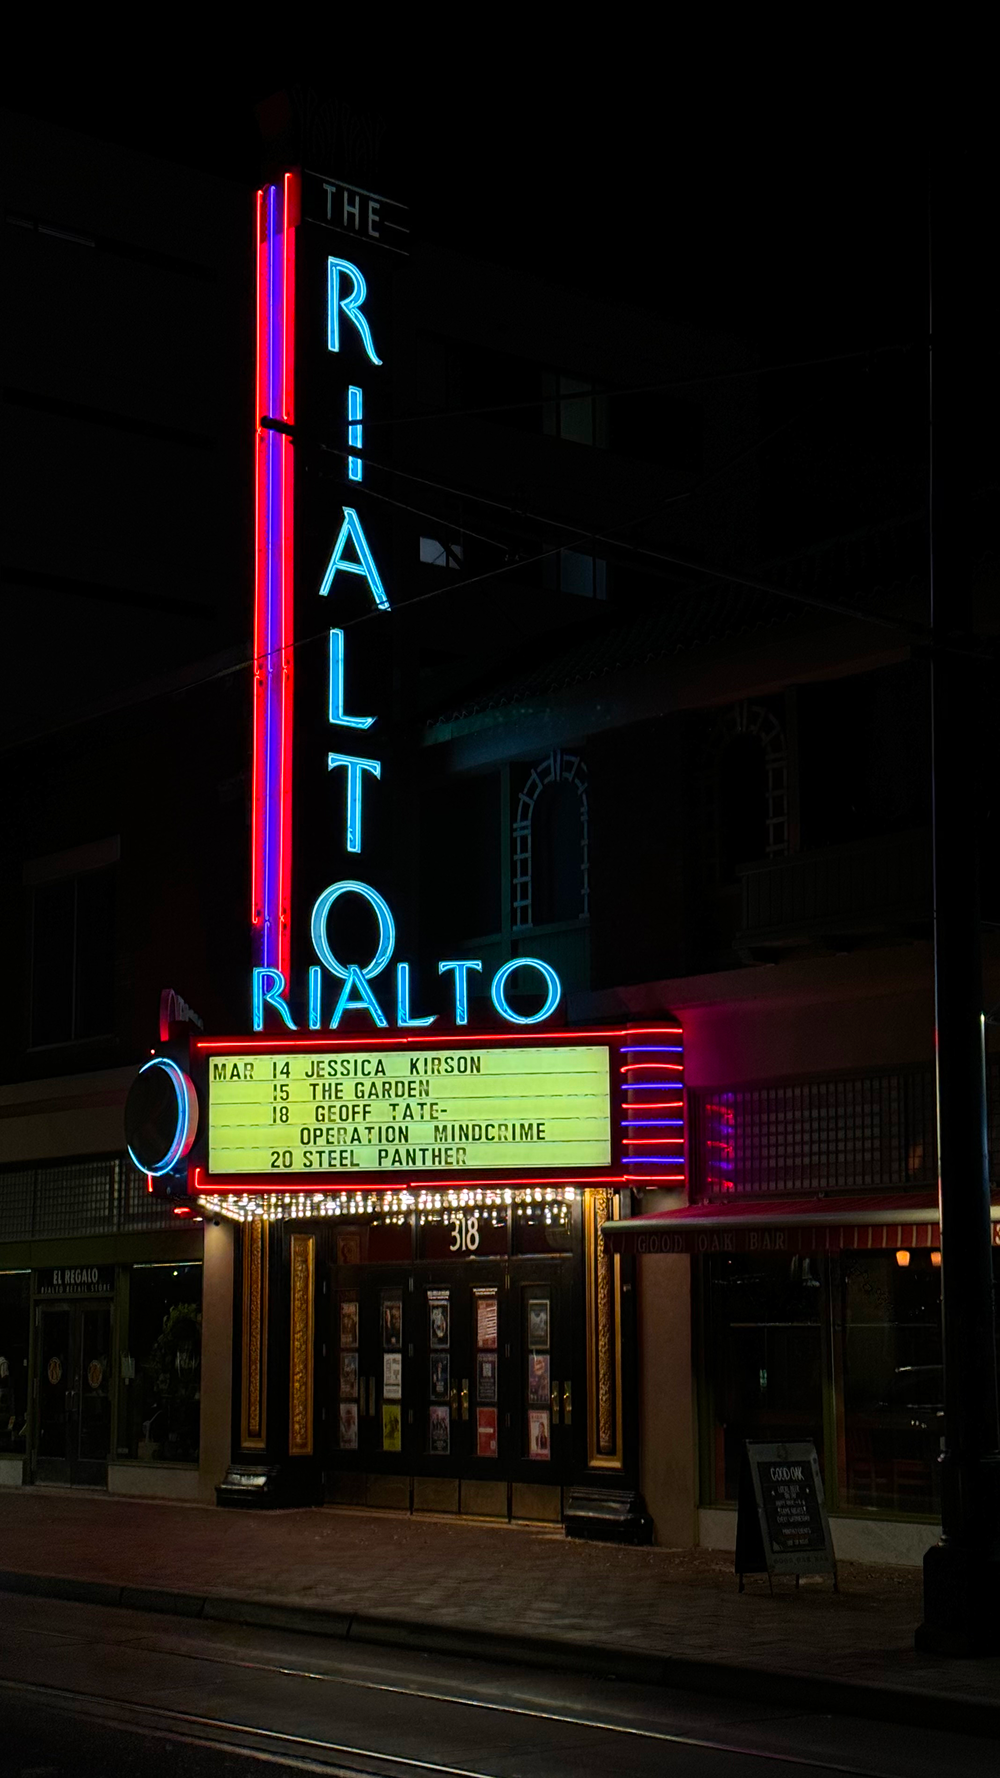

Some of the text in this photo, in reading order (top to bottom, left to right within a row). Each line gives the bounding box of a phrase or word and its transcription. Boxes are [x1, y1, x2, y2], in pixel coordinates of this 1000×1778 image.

[322, 182, 381, 238] THE
[310, 255, 396, 980] RIALTO
[252, 956, 562, 1031] RIALTO
[213, 1056, 481, 1080] MAR 14 JESSICA KIRSON
[272, 1079, 430, 1101] 15 THE GARDEN
[272, 1102, 447, 1124] 18 GEOFF TATE-
[300, 1122, 546, 1145] OPERATION MINDCRIME
[271, 1147, 467, 1168] 20 STEEL PANTHER
[449, 1217, 480, 1252] 318
[637, 1231, 785, 1252] GOOD OAK BAR
[53, 1268, 98, 1285] EL REGALO
